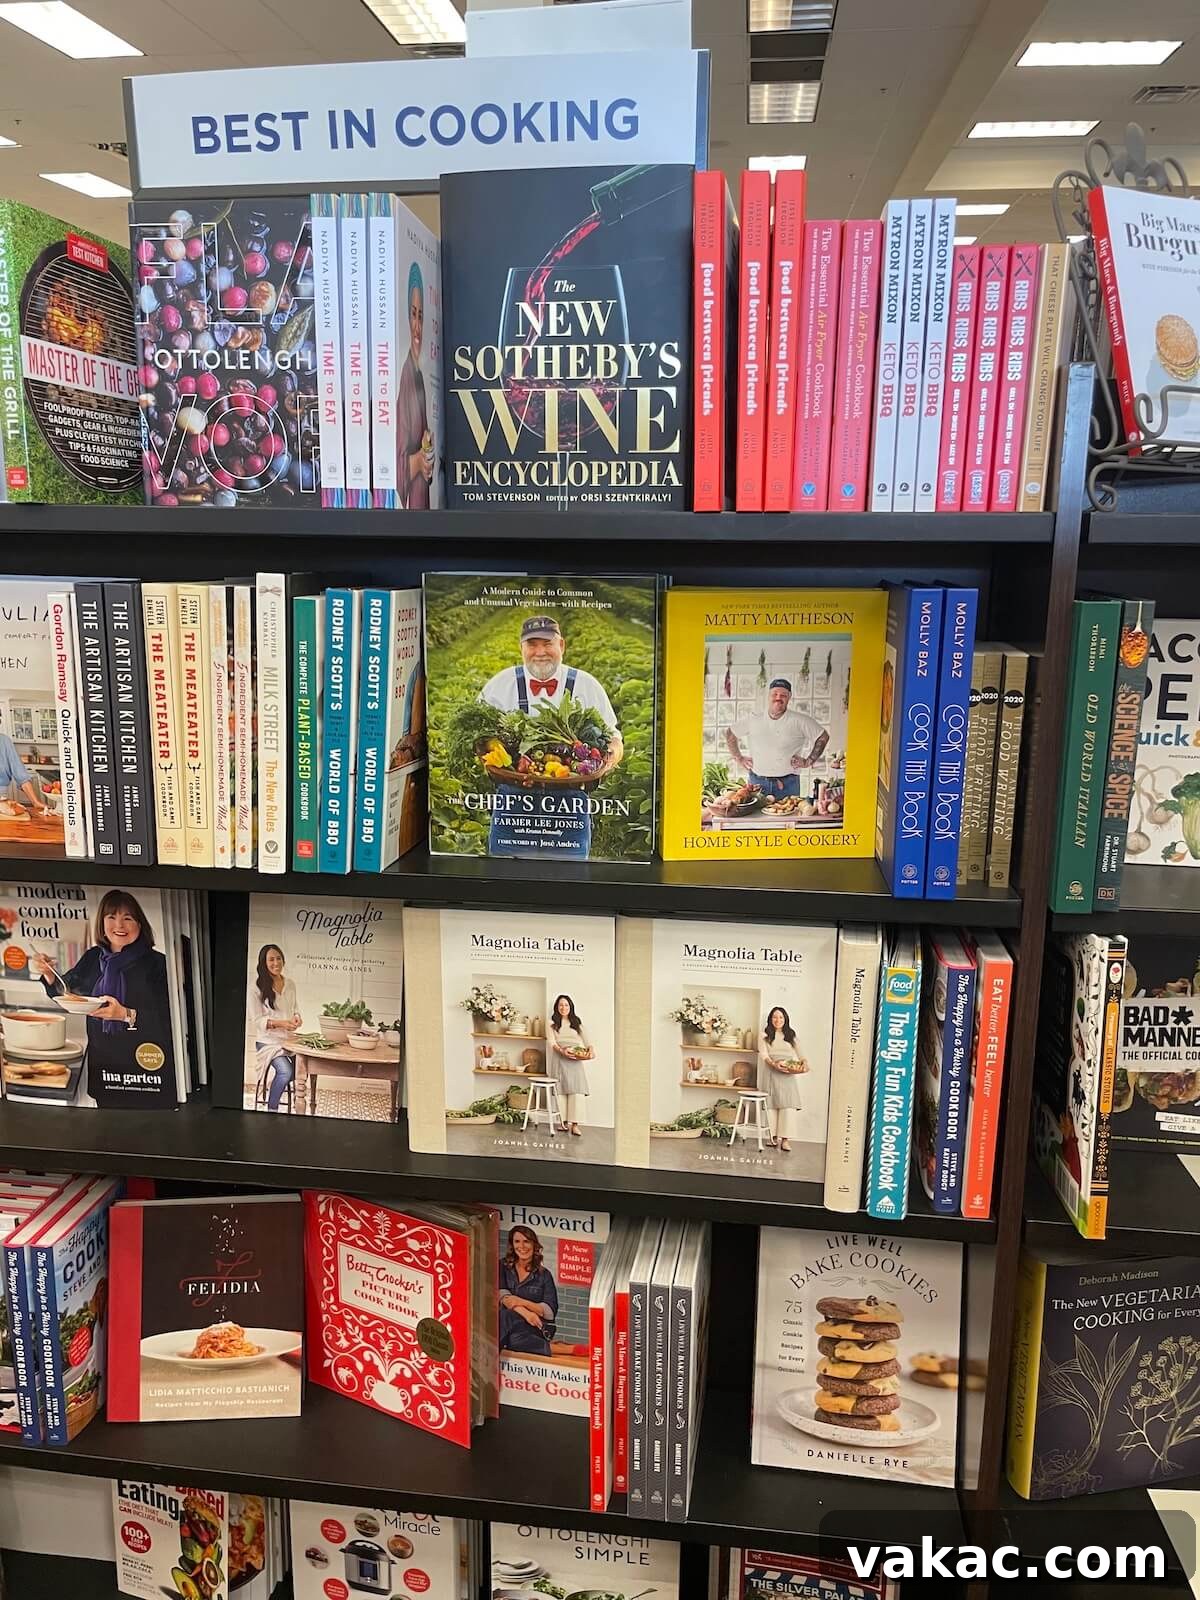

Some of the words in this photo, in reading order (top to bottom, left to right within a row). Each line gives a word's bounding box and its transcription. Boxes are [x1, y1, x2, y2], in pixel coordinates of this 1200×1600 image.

[191, 111, 308, 154] BEST
[328, 108, 376, 149] IN
[395, 97, 640, 147] COOKING
[1141, 212, 1164, 233] Big
[1165, 215, 1200, 232] Macs
[319, 230, 328, 274] NADIYA
[889, 216, 902, 271] MYRON
[1124, 222, 1200, 262] Burgu
[1051, 255, 1060, 274] THAT
[553, 280, 576, 293] The
[700, 262, 715, 297] food
[321, 279, 331, 329] HUSSAIN
[886, 274, 899, 324] MIXON
[956, 281, 973, 315] RIBS,
[1047, 279, 1057, 314] CHEESE
[515, 300, 617, 337] NEW
[702, 299, 714, 361] between
[1045, 315, 1055, 345] PLATE
[952, 318, 970, 350] RIBS,
[322, 342, 335, 376] TIME
[453, 342, 682, 382] SOTHEBY'S
[882, 343, 897, 380] KETO
[951, 352, 968, 383] RIBS
[1043, 345, 1051, 367] WILL
[326, 383, 334, 396] TO
[700, 364, 714, 416] friends
[879, 383, 894, 418] BBQ
[1038, 368, 1048, 408] CHANGE
[324, 400, 336, 425] EAT
[449, 386, 682, 455] WINE
[1035, 410, 1045, 437] YOUR
[1033, 437, 1041, 452] LIFE
[453, 460, 683, 488] ENCYCLOPEDIA
[463, 492, 484, 501] TOM
[486, 492, 541, 501] STEVENSON
[580, 493, 603, 502] ORSI
[605, 493, 672, 502] SZENTKIRALYI
[464, 598, 479, 606] and
[480, 598, 513, 607] Unusual
[581, 600, 612, 610] Recipes
[482, 587, 489, 595] A
[489, 587, 521, 597] Modern
[522, 588, 546, 597] Guide
[547, 588, 555, 597] to
[556, 588, 593, 597] Common
[82, 601, 98, 630] THE
[147, 599, 155, 626] RINELLA
[155, 600, 164, 625] STEVEN
[331, 599, 345, 651] RODNEY
[704, 612, 761, 626] MATTY
[764, 612, 855, 625] MATHESON
[920, 602, 932, 647] MOLLY
[52, 604, 64, 650] Gordon
[152, 632, 163, 664] THE
[299, 640, 307, 655] THE
[1088, 624, 1099, 672] THORISSON
[84, 637, 103, 703] ARTISAN
[299, 656, 308, 695] COMPLETE
[917, 651, 929, 677] BAZ
[57, 653, 68, 704] Ramsay
[263, 666, 279, 700] MILK
[330, 656, 344, 712] SCOTT'S
[153, 669, 170, 760] MEATEATER
[1087, 693, 1099, 725] OLD
[61, 708, 73, 744] Quick
[264, 703, 280, 753] STREET
[298, 699, 311, 780] PLANT-BASED
[906, 703, 931, 753] COOK
[89, 709, 109, 774] KITCHEN
[63, 747, 73, 769] and
[265, 760, 278, 778] The
[1079, 729, 1096, 783] WORLD
[327, 748, 342, 794] WORLD
[905, 759, 927, 783] THIS
[65, 771, 76, 826] Delicious
[265, 779, 278, 803] New
[300, 782, 309, 821] COOKBOOK
[464, 792, 535, 812] CHEF'S
[541, 797, 632, 817] GARDEN
[265, 805, 278, 833] Rules
[327, 799, 340, 817] OF
[902, 791, 926, 839] BOOK
[1074, 787, 1091, 849] ITALIAN
[325, 819, 340, 846] BBQ
[494, 817, 531, 827] FARMER
[534, 819, 552, 828] LEE
[554, 820, 585, 829] JONES
[683, 835, 730, 849] HOME
[735, 834, 783, 848] STYLE
[787, 834, 861, 847] COOKERY
[1101, 835, 1111, 873] FARRIMOND
[17, 885, 87, 900] modern
[18, 902, 89, 920] comfort
[296, 902, 384, 937] Magnolia
[20, 921, 59, 939] food
[335, 923, 375, 948] Table
[471, 934, 540, 951] Magnolia
[544, 937, 584, 952] Table
[308, 963, 340, 971] JOANNA
[342, 965, 373, 973] GAINES
[889, 1011, 910, 1036] The
[880, 1037, 908, 1064] Big,
[1122, 1051, 1140, 1061] THE
[1142, 1050, 1183, 1061] OFFICIAL
[1185, 1051, 1200, 1061] COO
[102, 1069, 121, 1082] ina
[123, 1073, 162, 1085] garten
[885, 1066, 906, 1093] Fun
[883, 1095, 904, 1124] Kids
[877, 1125, 902, 1192] Cookbook
[950, 1152, 958, 1173] STEVE
[948, 1174, 956, 1188] AND
[511, 1206, 596, 1234] Howard
[572, 1245, 589, 1253] New
[826, 1234, 859, 1250] LIVE
[868, 1235, 904, 1257] WELL
[560, 1262, 592, 1273] SIMPLE
[560, 1272, 592, 1283] Cooking
[1078, 1273, 1118, 1286] Deborah
[1120, 1269, 1159, 1281] Madison
[188, 1280, 261, 1296] FELIDIA
[361, 1280, 410, 1304] PICTURE
[1052, 1299, 1074, 1310] The
[1075, 1298, 1098, 1309] New
[1100, 1284, 1200, 1310] VEGETARIA
[353, 1289, 384, 1308] COOK
[388, 1300, 419, 1320] BOOK
[784, 1299, 803, 1314] 75
[782, 1318, 803, 1327] Classic
[782, 1330, 803, 1338] Cookie
[780, 1342, 804, 1351] Recipes
[777, 1366, 805, 1374] Occasion
[149, 1389, 173, 1397] LIDIA
[176, 1386, 233, 1395] MATTICCHIO
[235, 1384, 290, 1394] BASTIANICH
[807, 1449, 876, 1465] DANIELLE
[884, 1457, 909, 1469] RYE
[384, 1514, 441, 1536] Miracle
[517, 1525, 651, 1550] OTTOLENGHI
